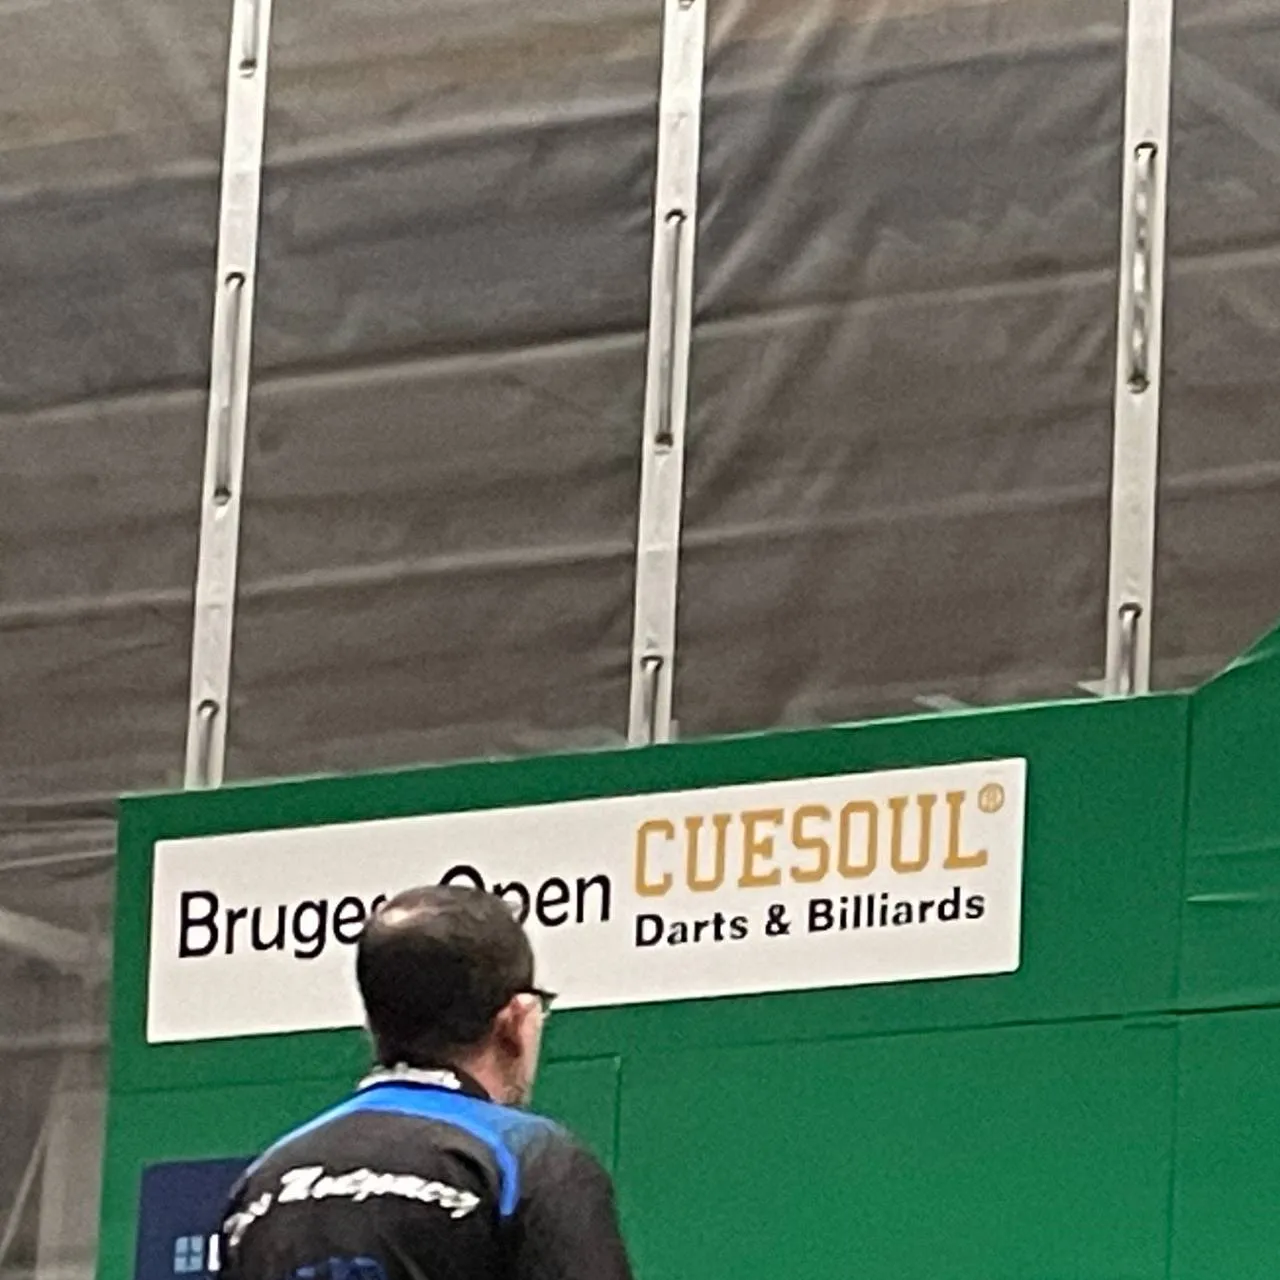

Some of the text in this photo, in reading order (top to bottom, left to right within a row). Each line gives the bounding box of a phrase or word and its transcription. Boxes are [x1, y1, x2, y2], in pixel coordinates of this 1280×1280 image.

[635, 885, 986, 948] Darts & Billiards
